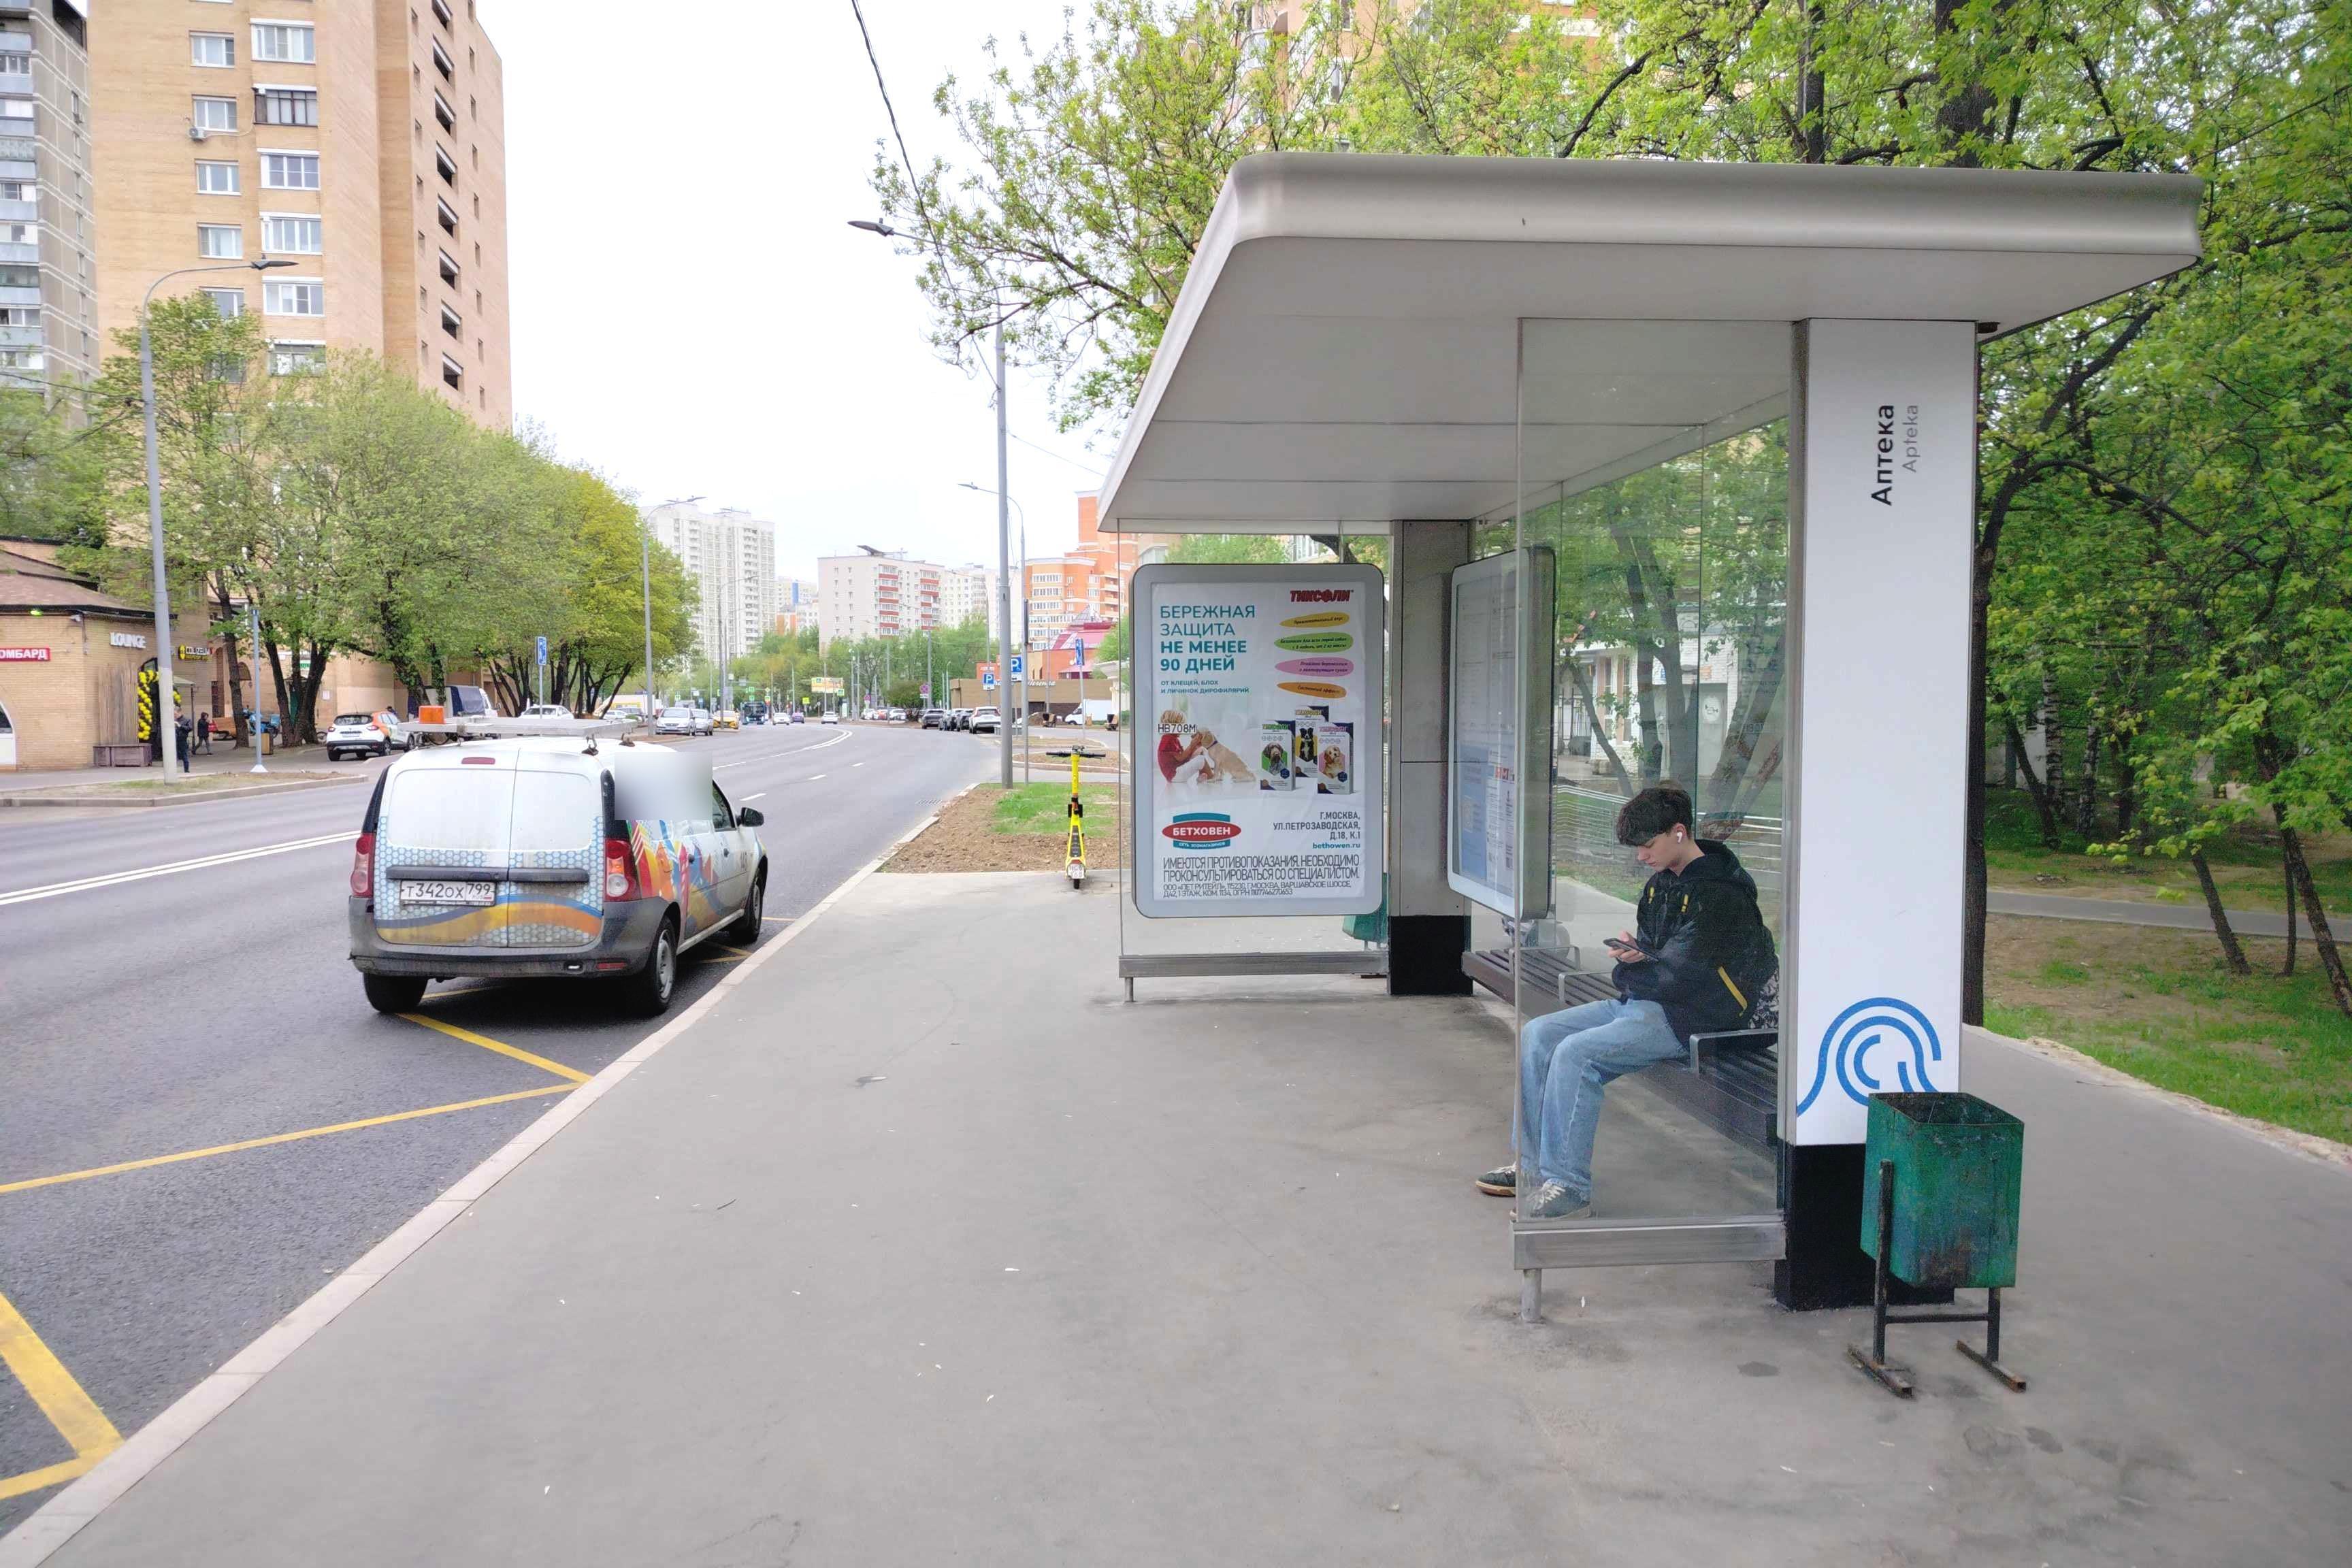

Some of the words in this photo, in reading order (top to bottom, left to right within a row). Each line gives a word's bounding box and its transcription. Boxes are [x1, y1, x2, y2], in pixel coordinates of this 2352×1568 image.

[1901, 405, 1921, 473] Apteka
[1871, 405, 1895, 506] Аптека
[1160, 605, 1255, 619] БЕРЕЖНАЯ
[1160, 623, 1236, 638] ЗАЩИТА
[110, 632, 146, 649] LOUNGE
[1160, 640, 1183, 653] НЕ
[1189, 640, 1247, 653] МЕНЕЕ
[1160, 658, 1180, 671] 90
[1185, 654, 1235, 674] ДНЕЙ
[1171, 679, 1200, 687] КЛЕЩЕЙ,
[1199, 687, 1250, 695] ДИРОФИЛЯРИЙ
[1320, 811, 1360, 820] Г.МОСКВА,
[1173, 826, 1230, 836] БЕТХОВЕН
[1273, 821, 1361, 831] УЛ.ПЕТРОЗАВОДСКАЯ,
[1329, 831, 1348, 840] Д.18,
[1350, 831, 1360, 839] К.1
[1312, 841, 1361, 849] bethowen.ru
[1163, 856, 1207, 870] ИМЕЮТСЯ
[1207, 855, 1300, 869] ПРОТИВОПОКАЗАНИЯ.
[1301, 854, 1360, 868] НЕОБХОДИМО
[1163, 868, 1274, 883] ПРОКОНСУЛЬТИРОВАТЬСЯ
[1275, 868, 1286, 880] СО
[1287, 867, 1360, 882] СПЕЦИАЛИСТОМ.
[406, 883, 465, 898] Т342ОХ
[467, 883, 491, 896] 799
